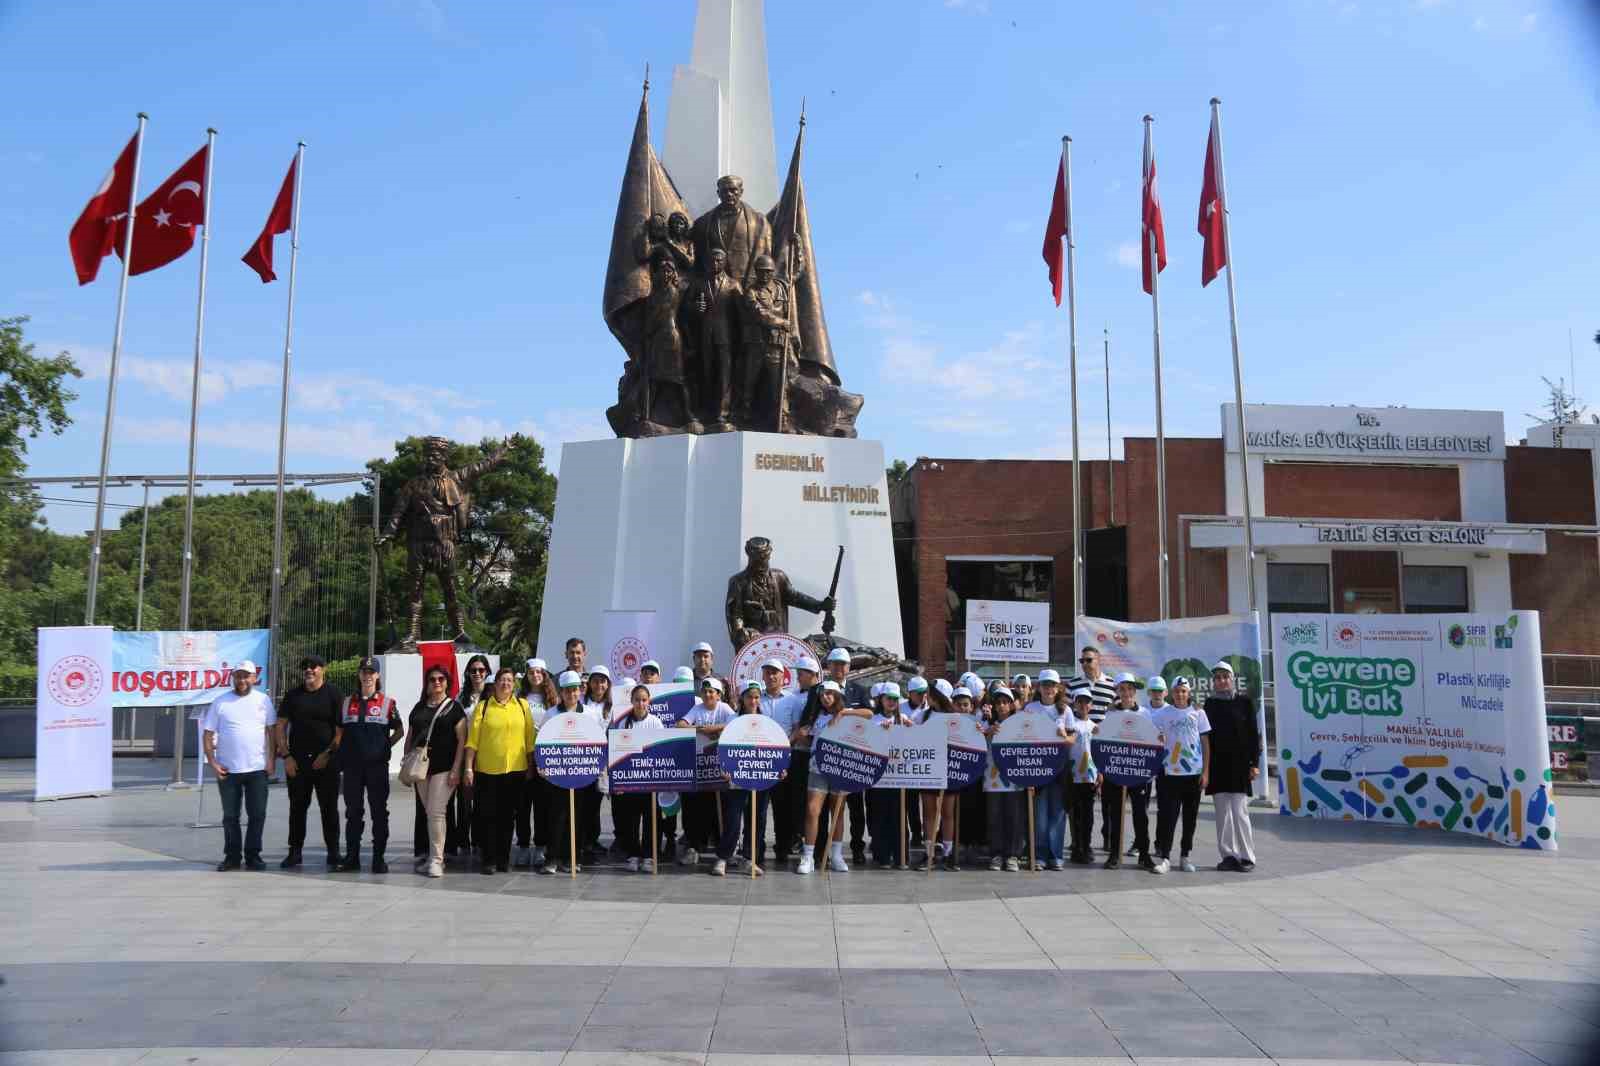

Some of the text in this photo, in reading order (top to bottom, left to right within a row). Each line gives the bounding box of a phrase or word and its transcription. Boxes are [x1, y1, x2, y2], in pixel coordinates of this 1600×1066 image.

[1357, 413, 1380, 426] T.C.
[1305, 431, 1401, 452] BÜYÜKŞEHİR
[1407, 434, 1491, 452] BELEDİYESİ
[755, 453, 824, 472] EGEMENLİK
[803, 482, 879, 504] MİLLETİNDİR
[1373, 525, 1424, 543] SERGİ
[1429, 528, 1487, 544] SALONU
[984, 622, 1033, 635] YEŞİLİ SEV
[1467, 625, 1486, 635] SIFIR
[982, 637, 1034, 648] HAYATI SEV
[1291, 653, 1412, 684] Çevrene
[1437, 672, 1473, 687] Plastik
[1306, 682, 1398, 715] İyi Bak
[1461, 696, 1504, 711] Mücadele
[1417, 717, 1434, 726] T.C.
[1387, 725, 1422, 736] MANİSA
[1547, 725, 1577, 742] RE
[540, 747, 561, 755] DOĞA
[563, 746, 584, 755] SENİN
[727, 748, 783, 759] UYGAR İNSAN
[821, 742, 841, 755] DOĞA
[842, 748, 863, 761] SENİN
[902, 748, 935, 760] ÇEVRE
[950, 750, 979, 762] DOSTU
[1000, 747, 1059, 758] ÇEVRE DOSTU
[1100, 744, 1156, 758] UYGAR İNSAN
[545, 757, 599, 766] ONU KORUMAK
[631, 756, 675, 767] TEMİZ HAVA
[738, 759, 773, 770] ÇEVREYİ
[823, 753, 876, 774] ONU KORUMAK
[1016, 757, 1042, 766] İNSAN
[1110, 756, 1146, 767] ÇEVREYİ
[545, 766, 600, 776] SENİN GÖREVİN
[613, 768, 694, 780] SOLUMAK İSTİYORUM
[734, 769, 780, 780] KİRLETMEZ
[820, 763, 841, 775] SENİN
[842, 769, 874, 785] GÖREVİN
[897, 763, 910, 774] EL
[912, 764, 931, 774] ELE
[1008, 768, 1054, 777] DOSTUDUR
[1105, 766, 1151, 777] KİRLETMEZ
